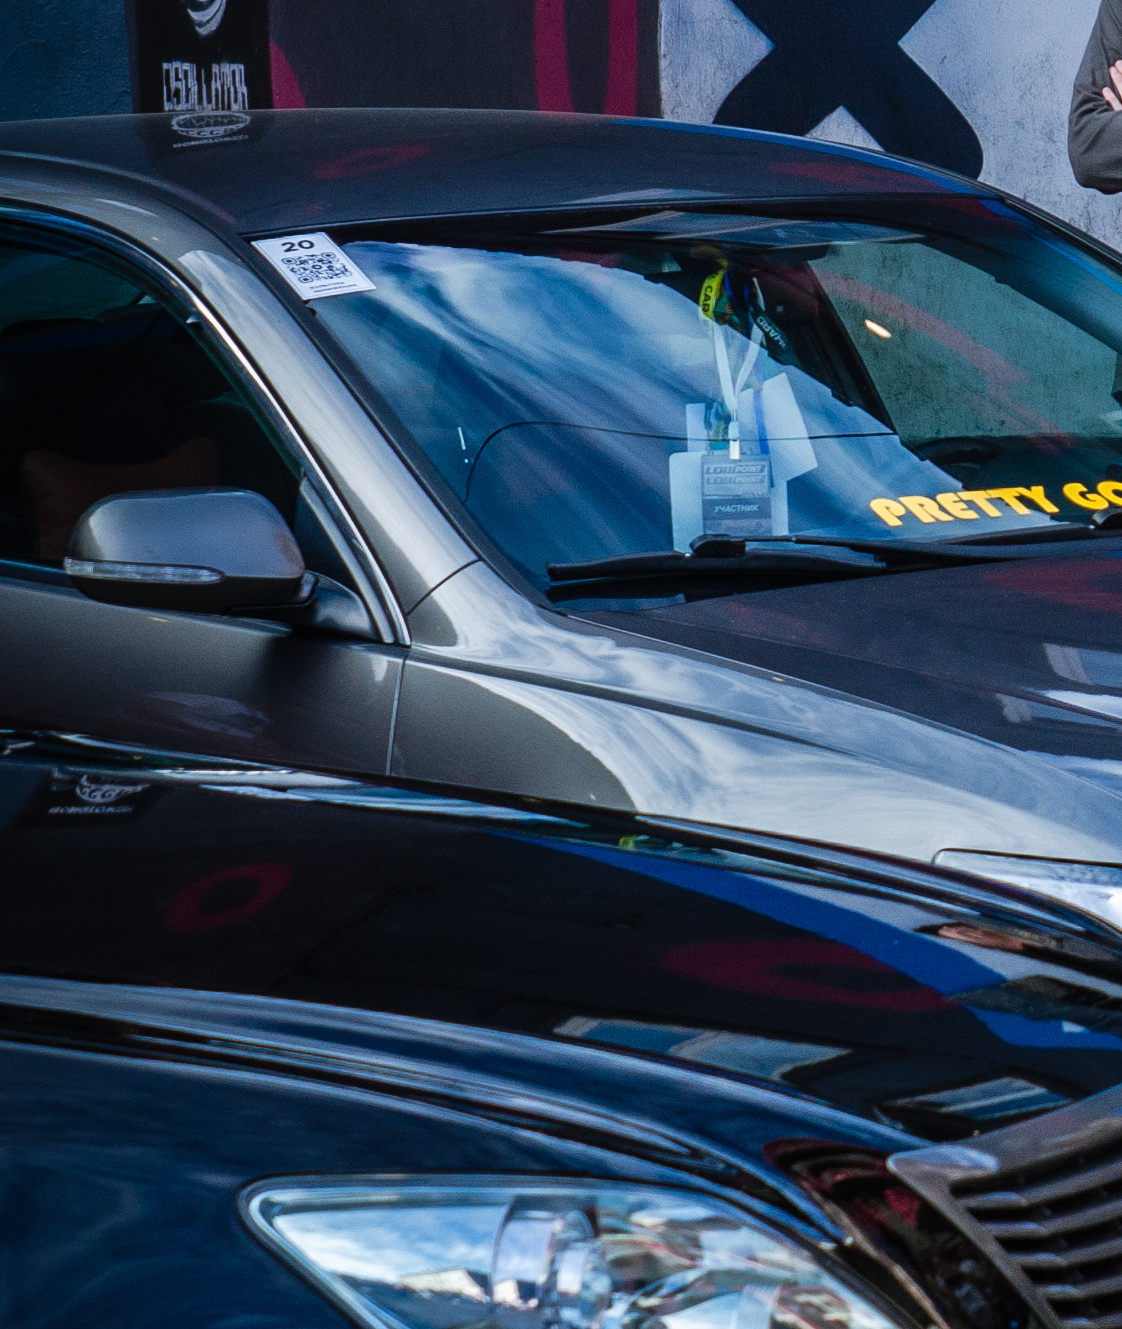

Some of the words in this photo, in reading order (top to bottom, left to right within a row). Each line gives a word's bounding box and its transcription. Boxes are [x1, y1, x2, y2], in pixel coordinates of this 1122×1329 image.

[281, 239, 315, 253] 20
[713, 503, 760, 514] УЧАСТНИК
[869, 485, 1060, 527] PRETTY
